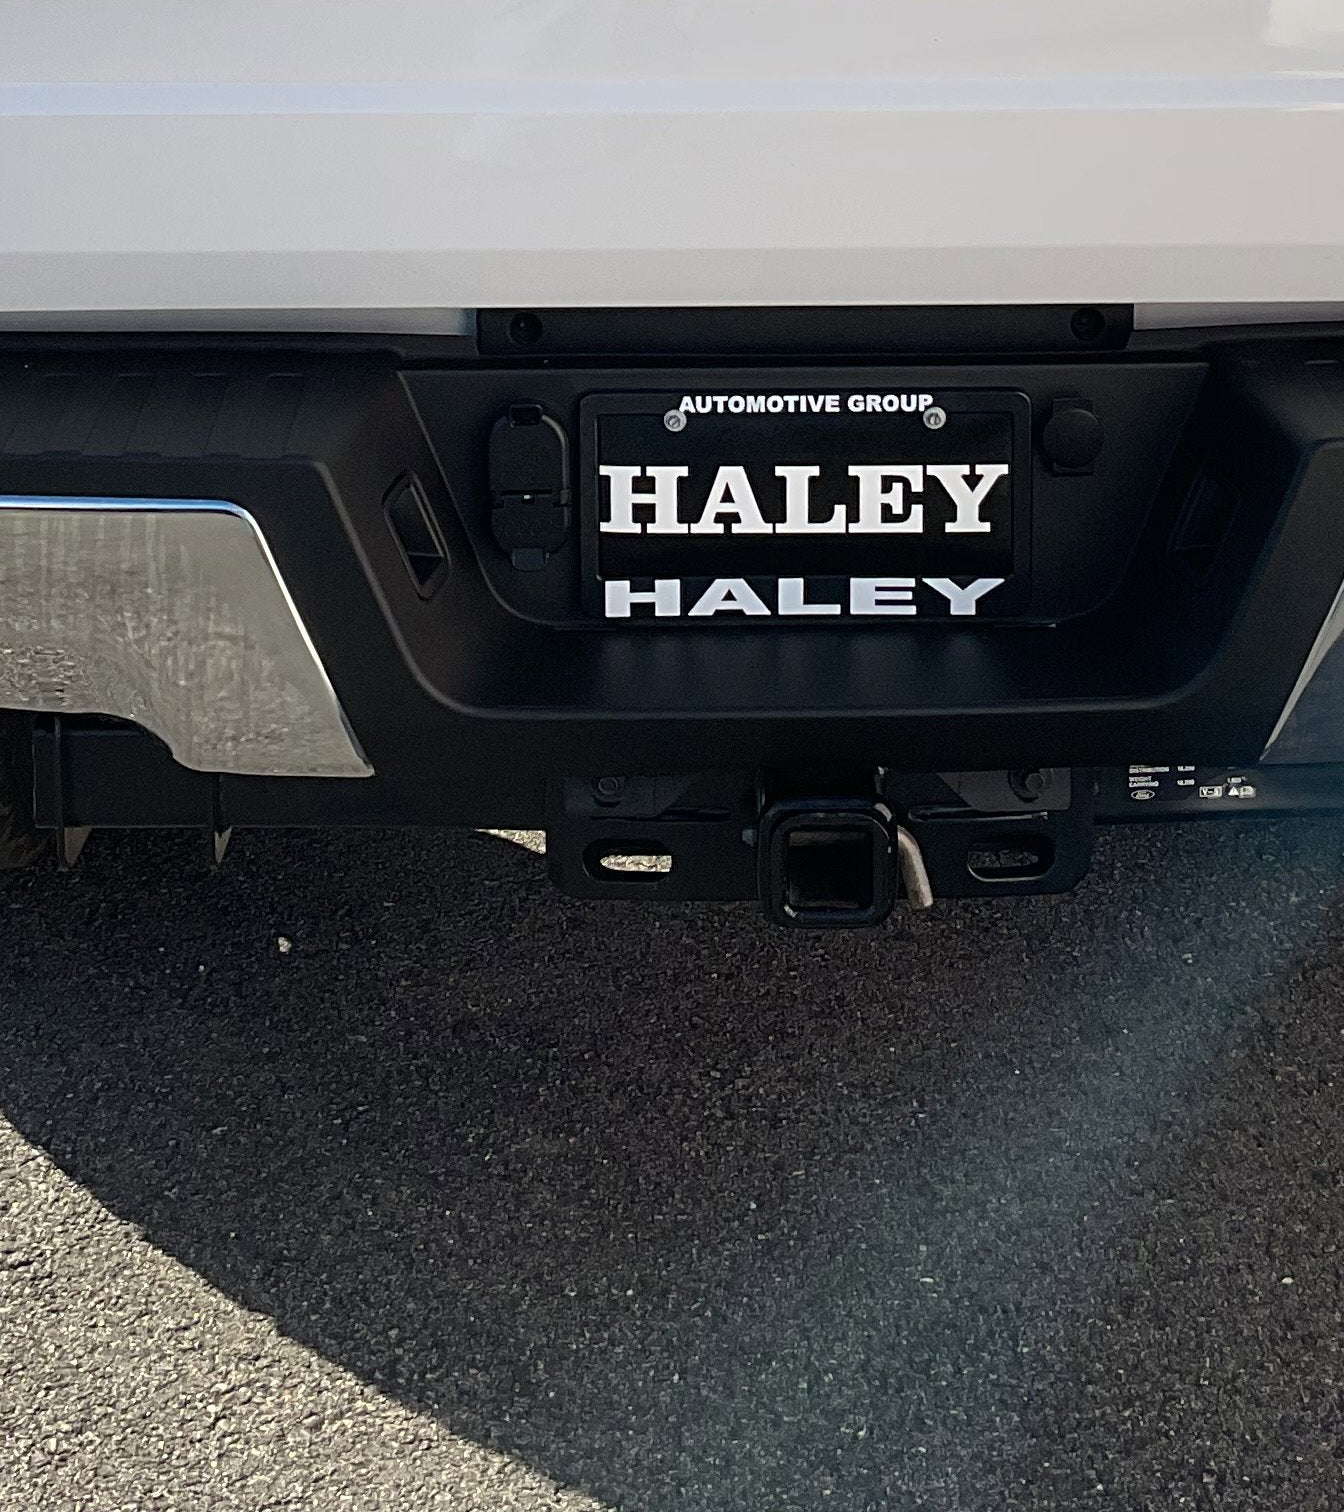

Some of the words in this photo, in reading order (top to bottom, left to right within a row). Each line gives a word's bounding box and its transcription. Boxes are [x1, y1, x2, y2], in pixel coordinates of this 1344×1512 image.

[678, 394, 841, 414] AUTOMOTIVE
[847, 393, 934, 413] GROUP
[598, 463, 1010, 535] HALEY
[604, 576, 1006, 618] HALEY
